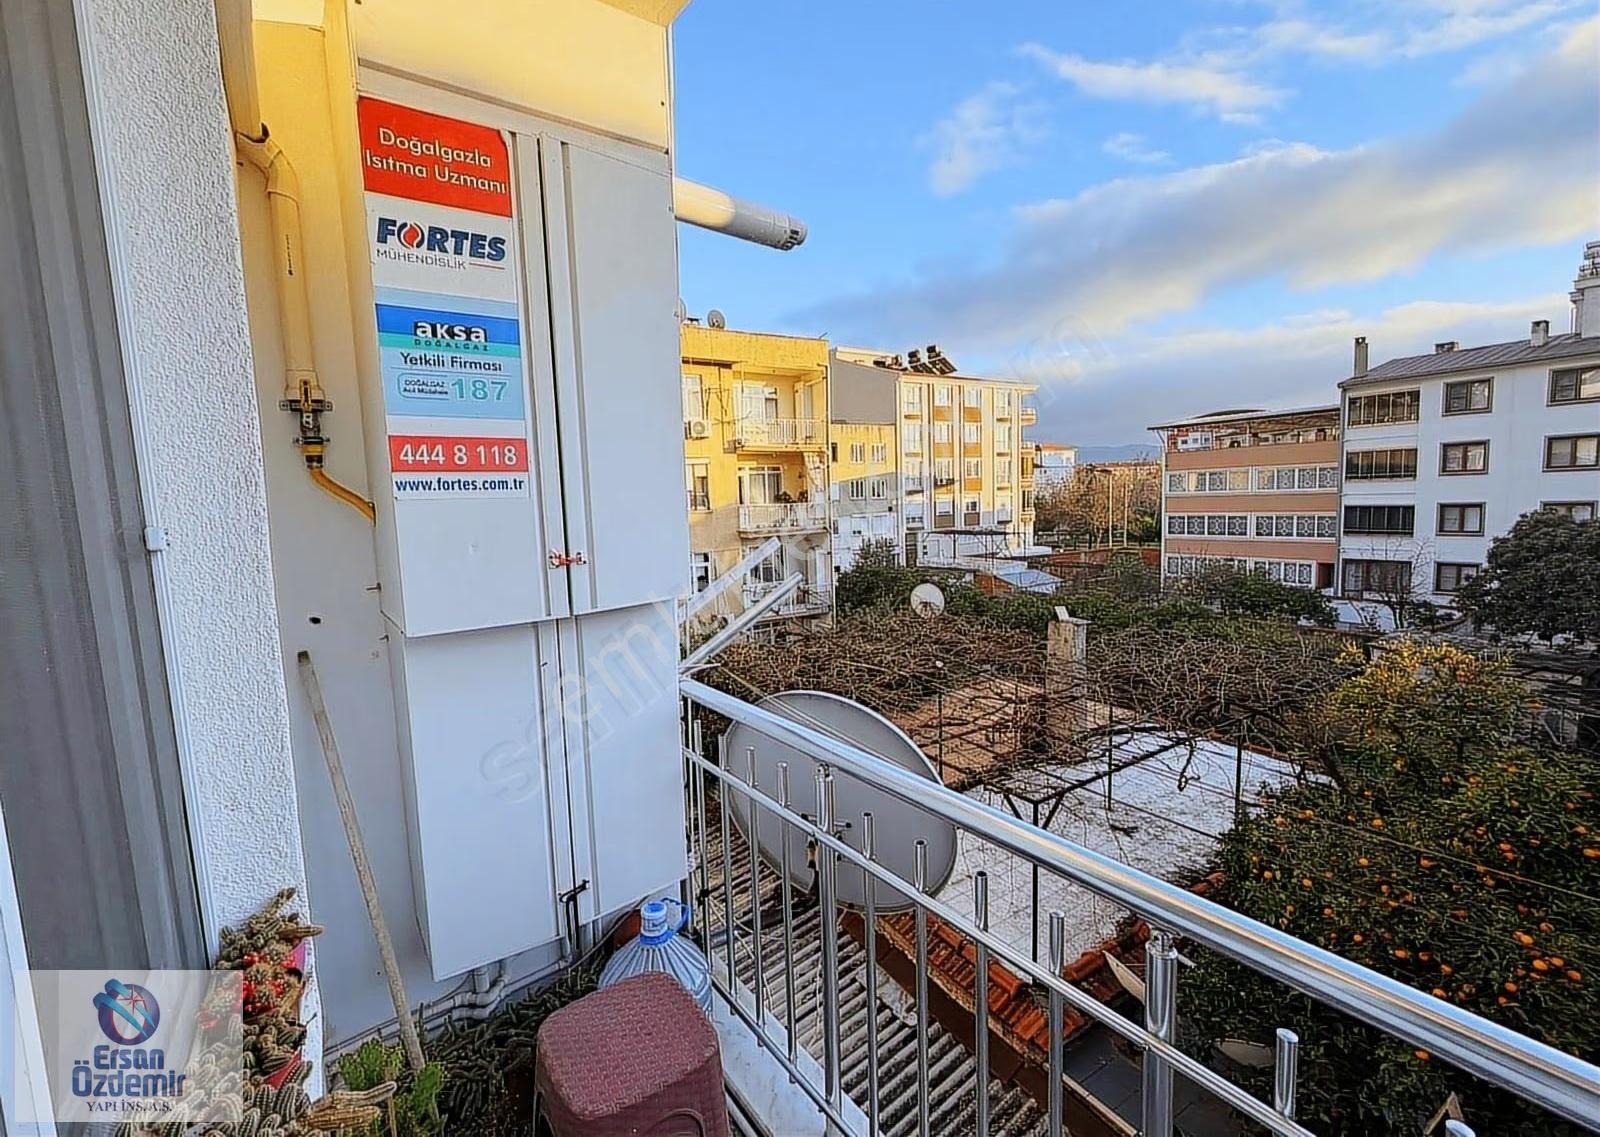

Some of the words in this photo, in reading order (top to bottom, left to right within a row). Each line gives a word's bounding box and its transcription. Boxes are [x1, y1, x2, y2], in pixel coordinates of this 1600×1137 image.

[379, 127, 491, 167] Doğalgazla
[365, 150, 427, 178] Isıtma
[435, 166, 506, 194] Uzmanı
[377, 217, 506, 261] FORTES
[377, 249, 467, 270] MÜHENDİSLİK
[415, 321, 486, 342] aksa
[414, 338, 488, 351] DOĞALGAZ
[400, 352, 445, 368] Yetkili
[450, 356, 502, 372] Firması
[451, 377, 508, 401] 187
[400, 443, 446, 464] 444
[454, 444, 468, 465] 8
[476, 445, 517, 465] 118
[395, 477, 524, 491] www.fortes.com.tr
